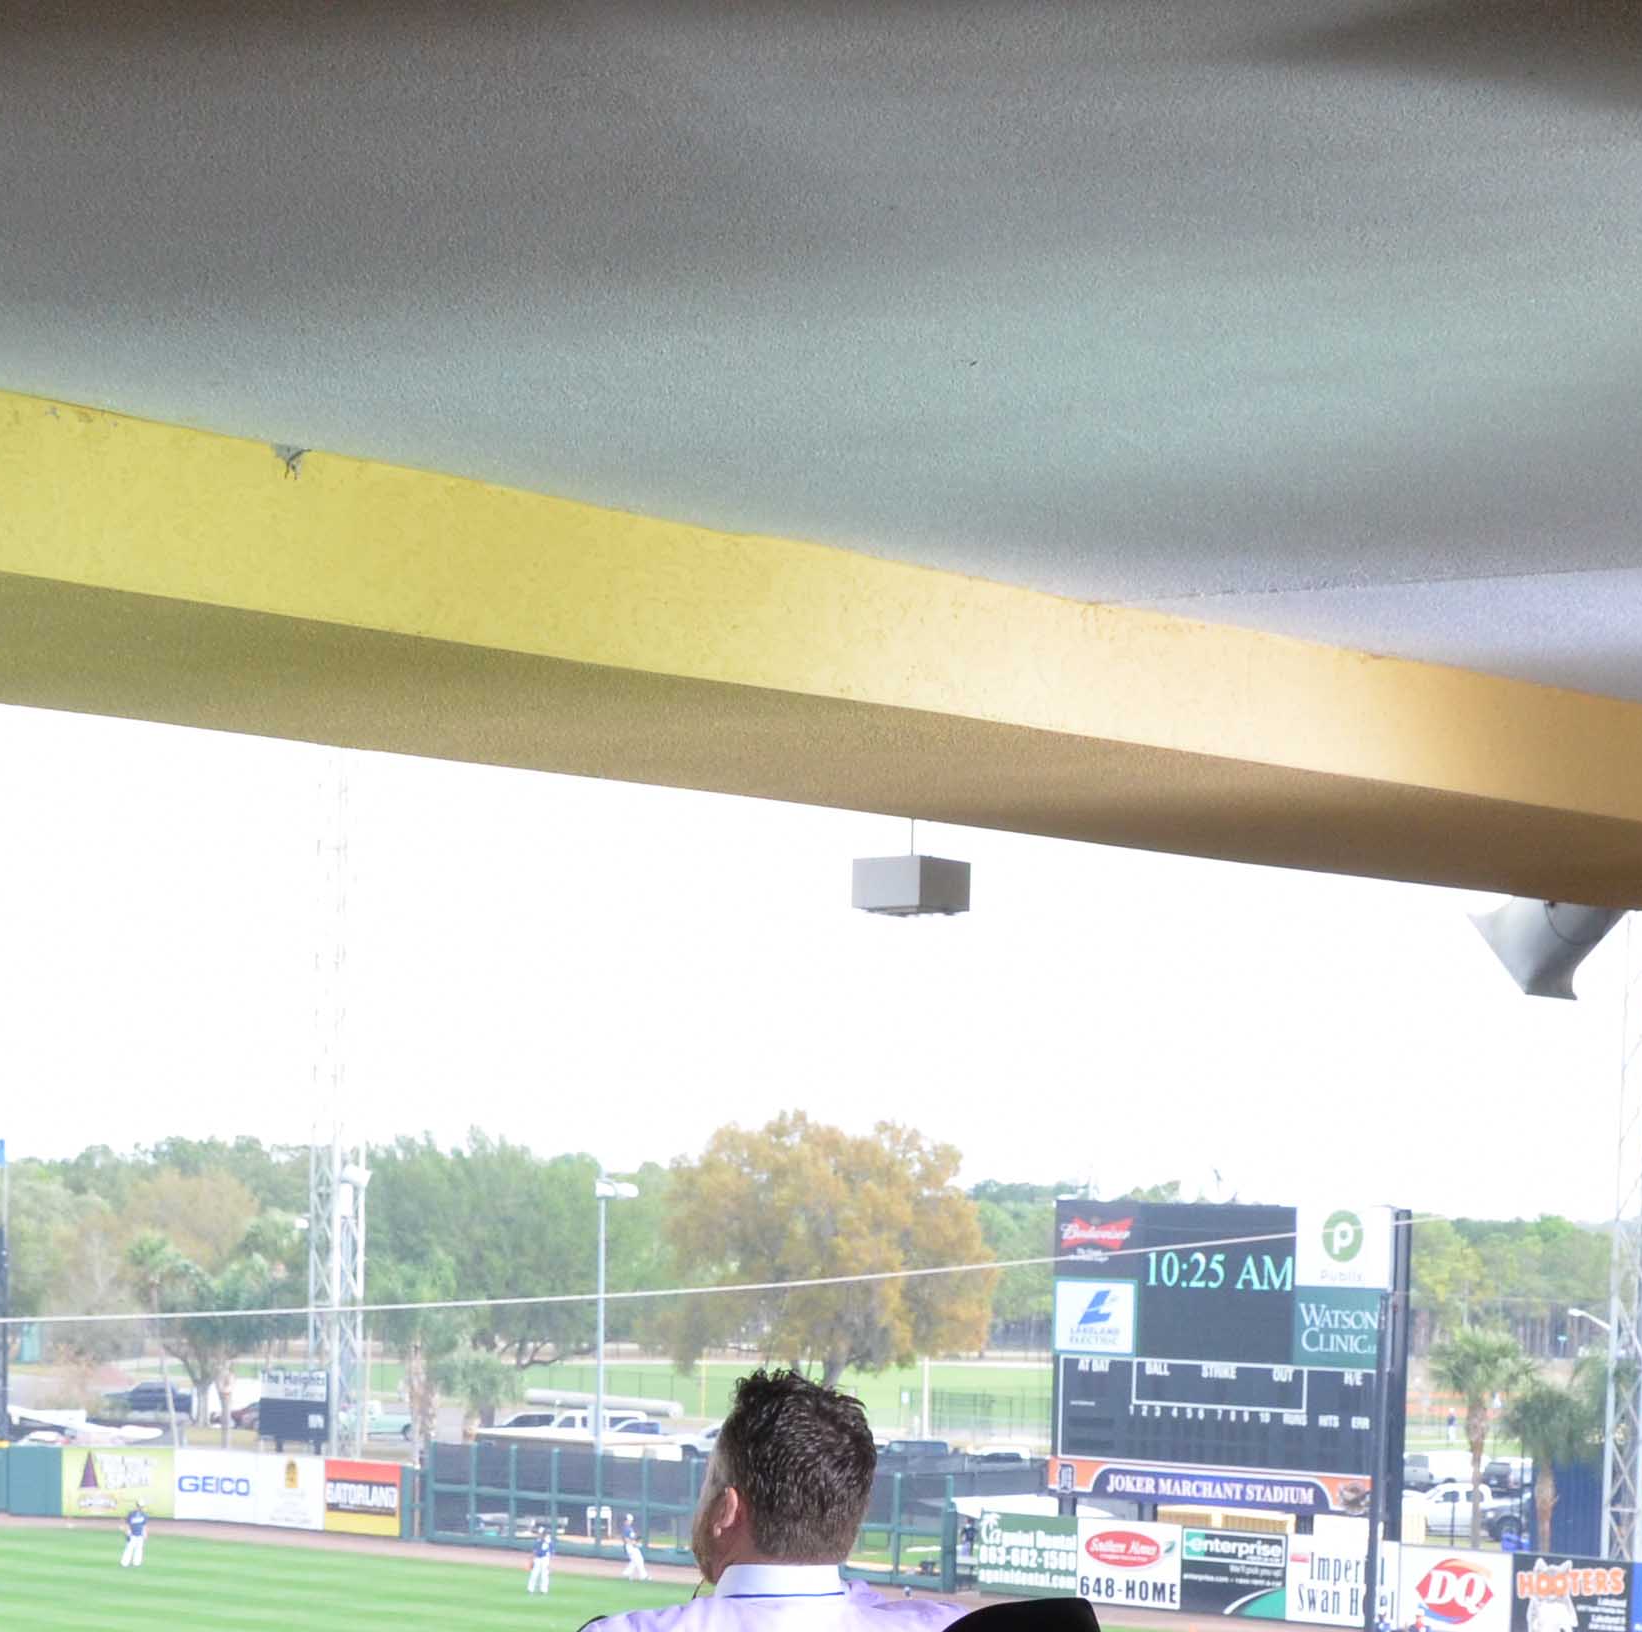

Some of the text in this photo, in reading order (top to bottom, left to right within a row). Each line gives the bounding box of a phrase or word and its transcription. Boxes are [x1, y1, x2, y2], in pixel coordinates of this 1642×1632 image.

[1146, 1251, 1294, 1292] 10:25 AM
[1298, 1303, 1378, 1330] WATSON
[1301, 1328, 1368, 1354] CLINIC
[1201, 1364, 1237, 1380] STRIKE
[1272, 1367, 1294, 1382] OUT
[178, 1475, 251, 1496] GEICO
[325, 1482, 398, 1509] GATORLAND
[1106, 1473, 1315, 1505] JOKER MARCHANT STADIUM
[1188, 1536, 1283, 1558] enterprise
[1309, 1551, 1385, 1587] Imperl
[1517, 1567, 1626, 1599] HOOTERS
[1079, 1575, 1178, 1604] 648-HOME
[1297, 1583, 1395, 1620] Swan Hel
[1425, 1568, 1488, 1613] DQ
